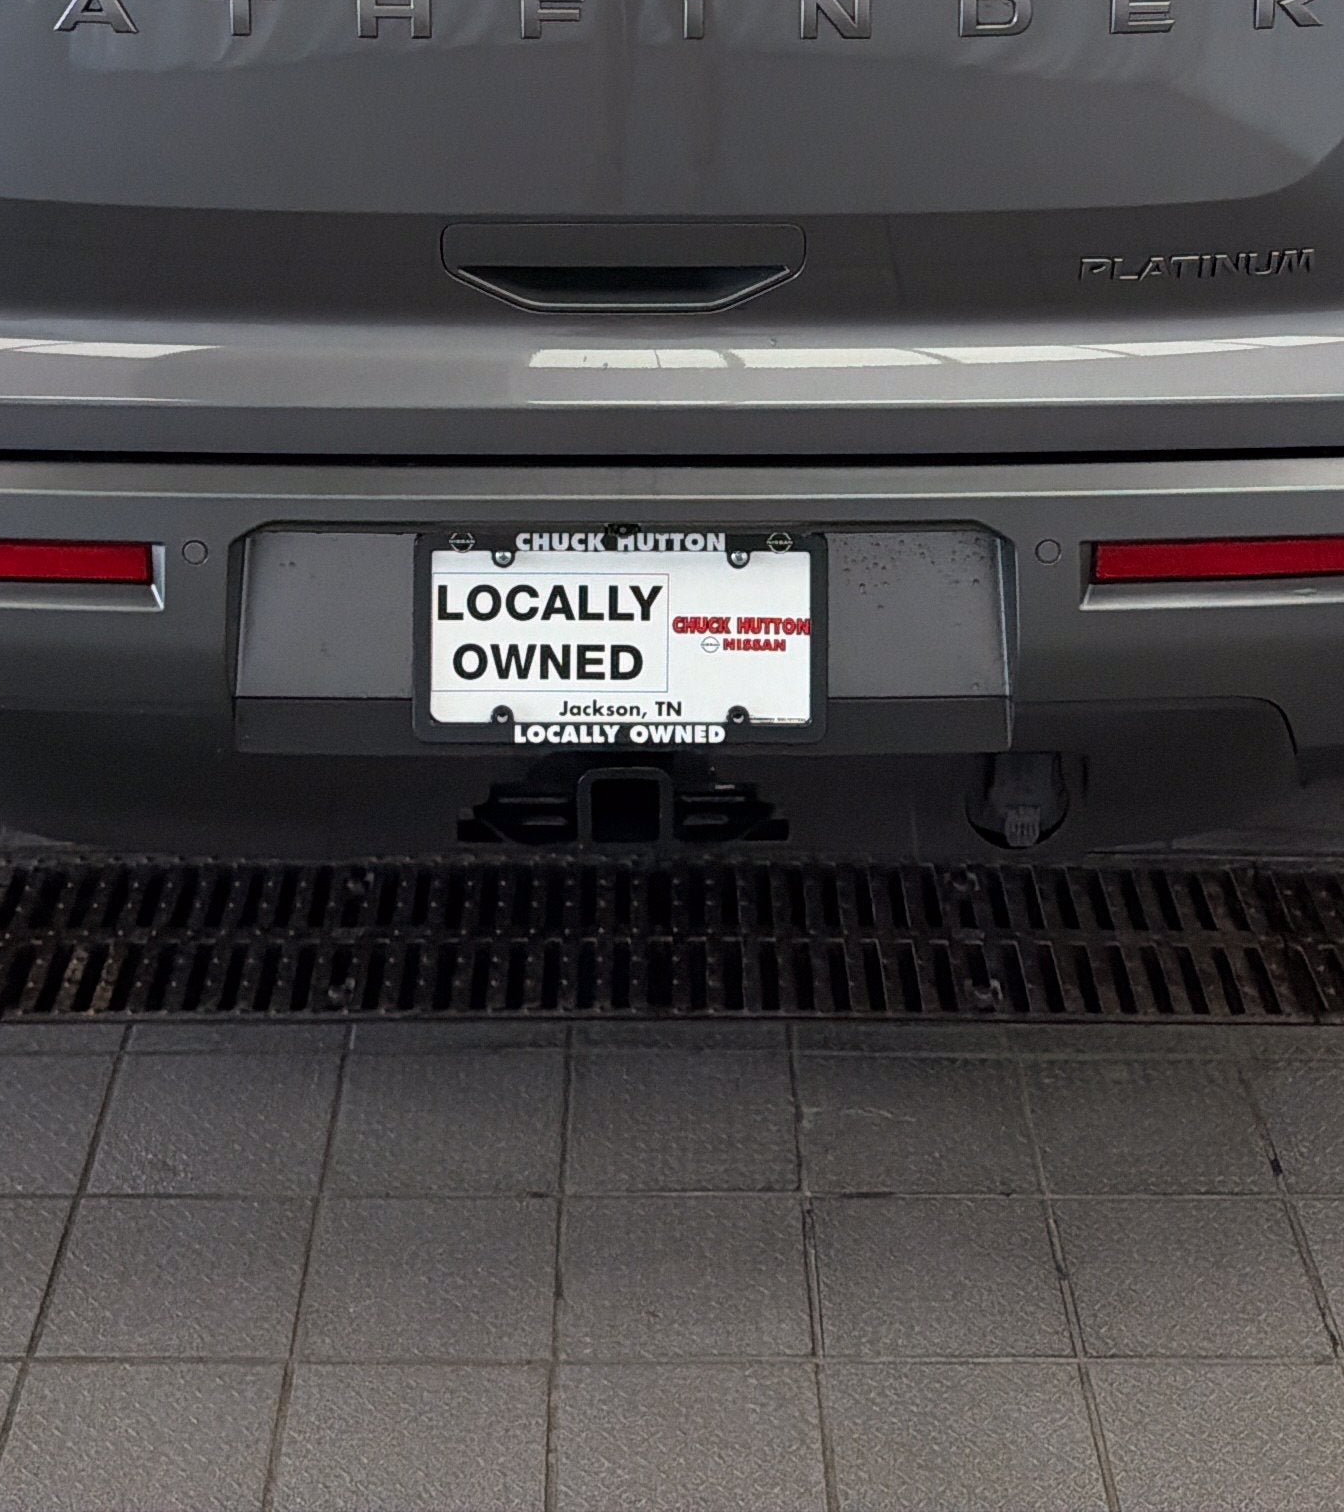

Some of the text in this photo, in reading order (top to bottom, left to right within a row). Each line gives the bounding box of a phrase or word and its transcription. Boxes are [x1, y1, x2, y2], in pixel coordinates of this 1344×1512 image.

[1078, 248, 1315, 281] PLATINUM
[515, 532, 726, 552] CHUCK HUTTON
[437, 584, 663, 622] LOCALLY
[672, 616, 812, 636] CHUCK HUTTON
[722, 638, 787, 652] NISSAN
[452, 643, 644, 681] OWNED
[558, 699, 682, 719] Jackson, TN
[513, 724, 726, 744] LOCALLY OWNED
